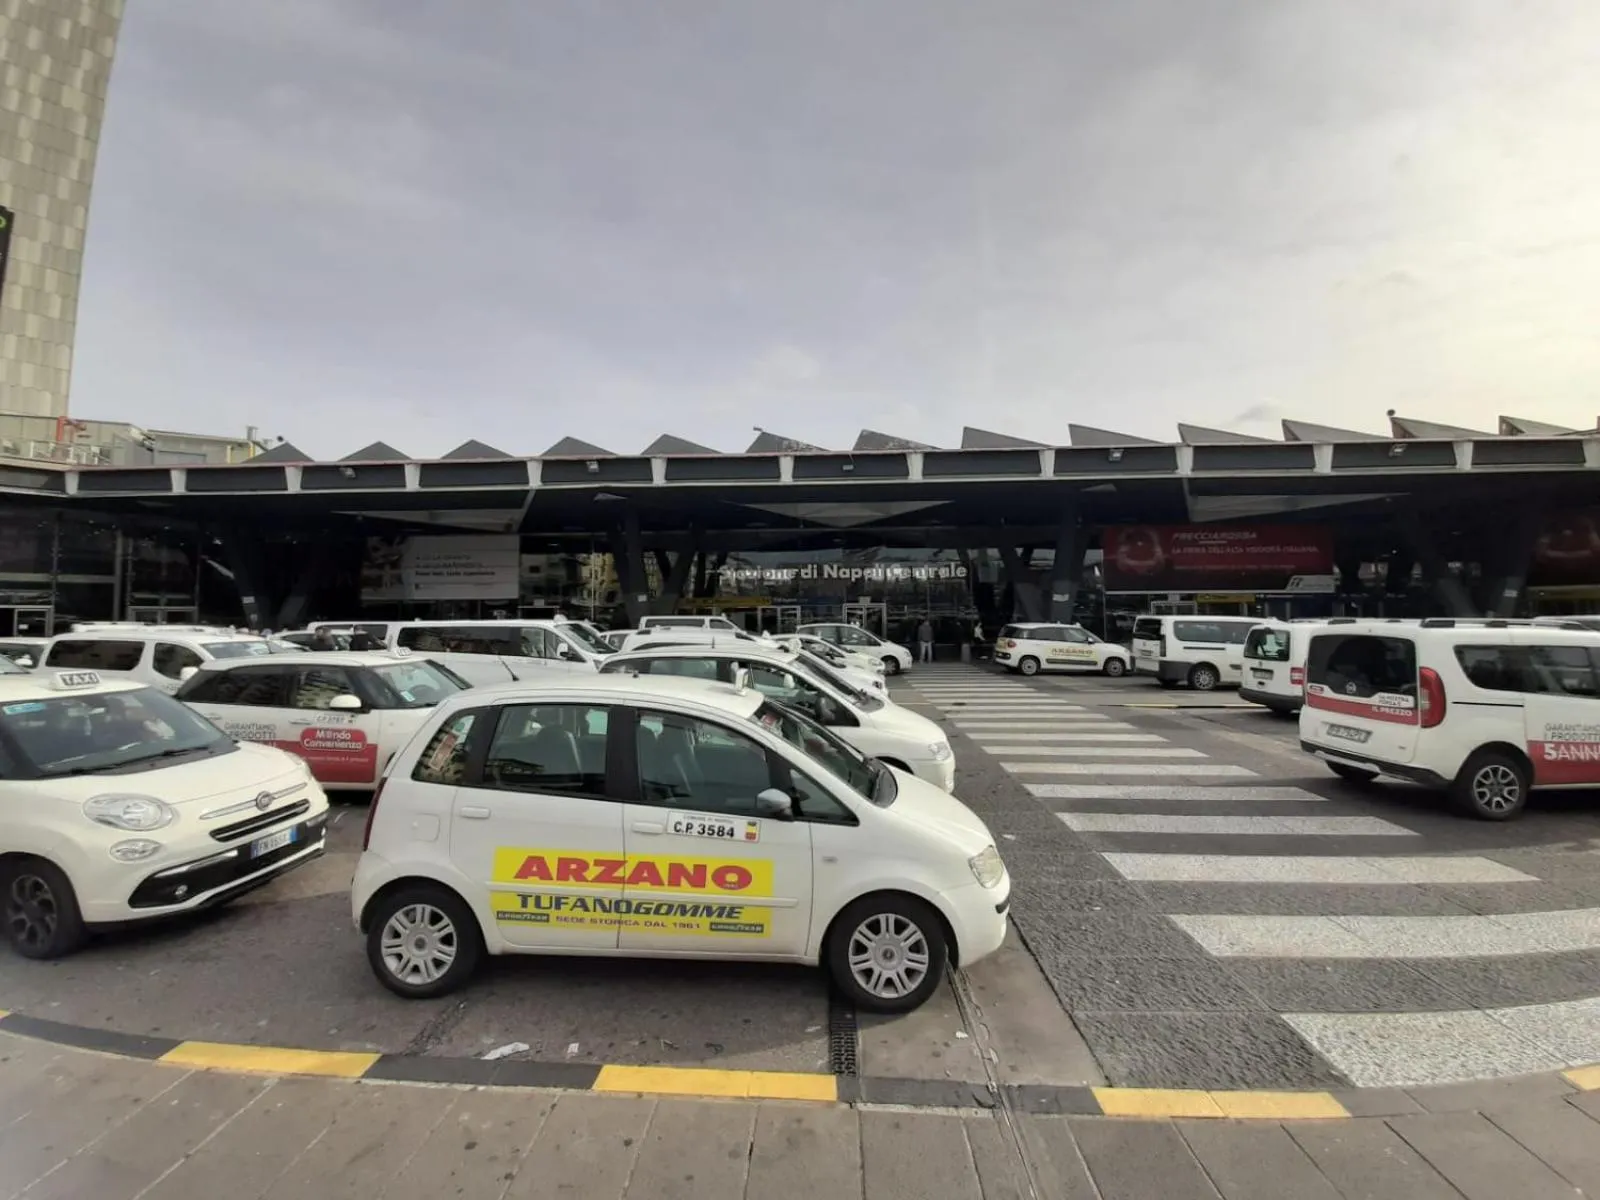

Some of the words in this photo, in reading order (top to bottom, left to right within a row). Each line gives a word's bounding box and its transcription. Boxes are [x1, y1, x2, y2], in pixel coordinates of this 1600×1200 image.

[800, 564, 818, 578] di
[823, 564, 884, 582] Napoli
[886, 564, 968, 580] Centrale
[60, 672, 100, 686] TAXI
[303, 738, 363, 749] Convenienza
[697, 823, 735, 838] 3584
[513, 855, 753, 891] ARZANO
[516, 893, 745, 919] TUFANOGOMME
[556, 915, 585, 924] SEDE
[590, 918, 640, 927] STORICA
[644, 920, 668, 928] DAL
